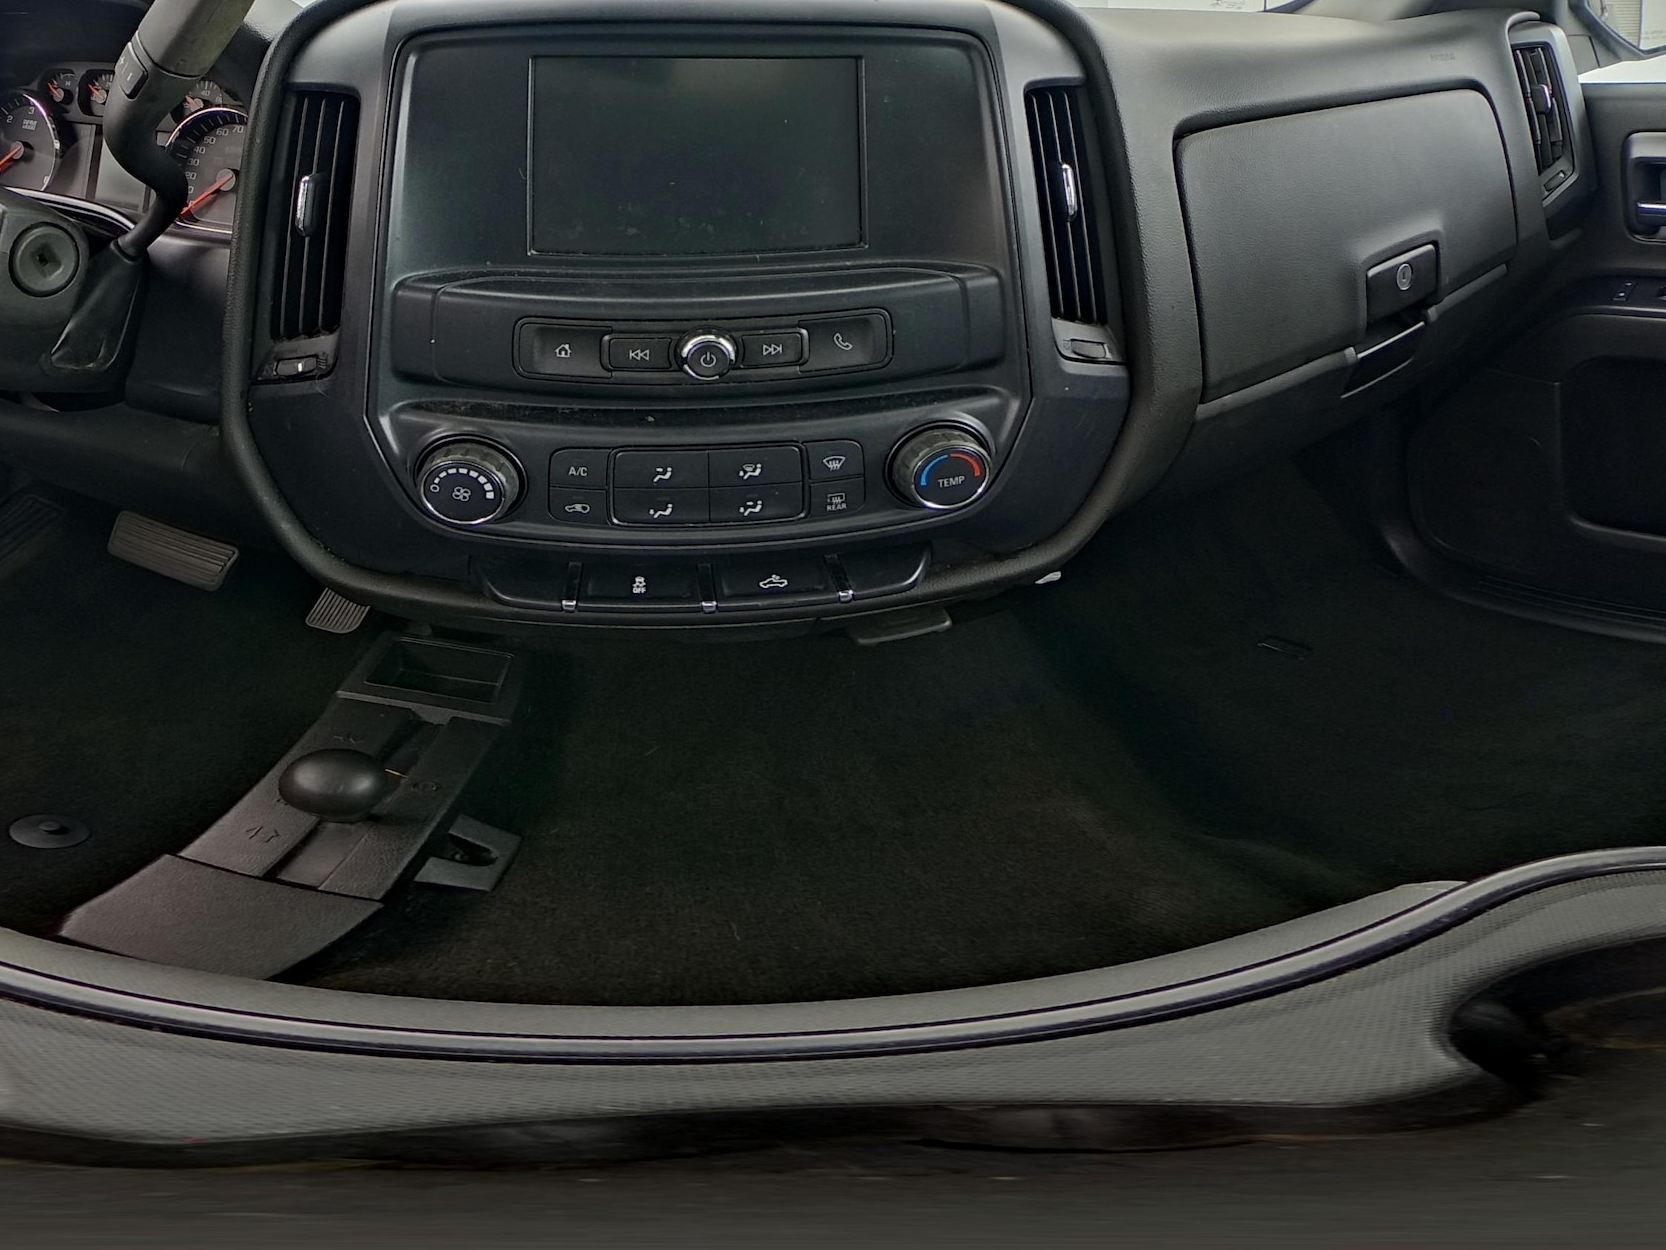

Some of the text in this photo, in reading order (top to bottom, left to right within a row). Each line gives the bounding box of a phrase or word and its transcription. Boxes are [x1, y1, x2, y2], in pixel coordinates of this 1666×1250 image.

[216, 127, 229, 137] 60
[204, 136, 216, 145] 50
[194, 146, 206, 154] 40
[568, 465, 588, 478] A/C
[937, 475, 966, 489] TEMP
[826, 501, 848, 511] REAR
